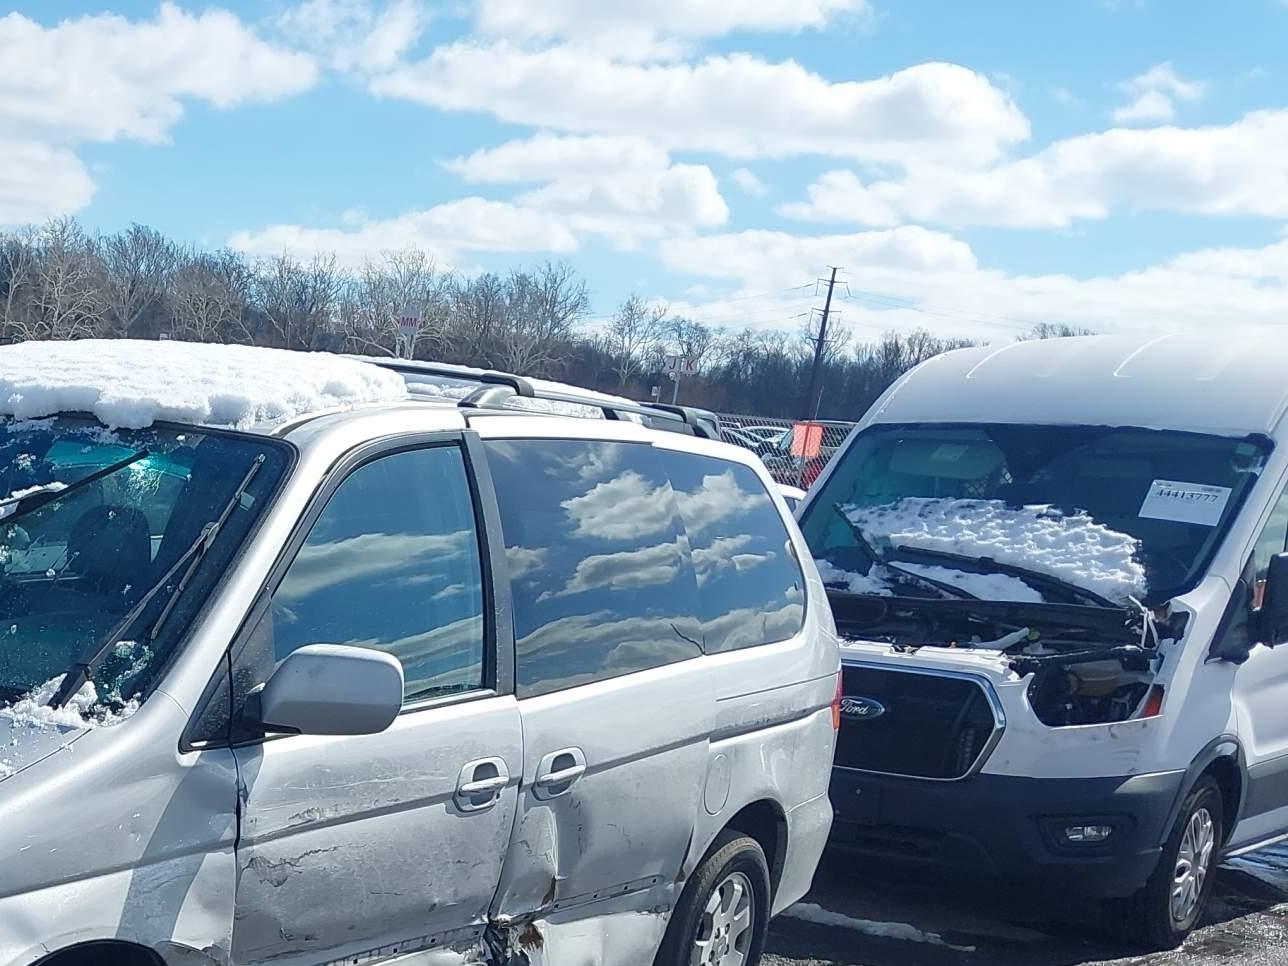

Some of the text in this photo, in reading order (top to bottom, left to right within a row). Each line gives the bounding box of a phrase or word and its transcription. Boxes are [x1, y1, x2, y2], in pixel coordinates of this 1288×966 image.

[668, 358, 677, 370] J
[685, 359, 695, 371] K
[840, 699, 871, 715] Ford
